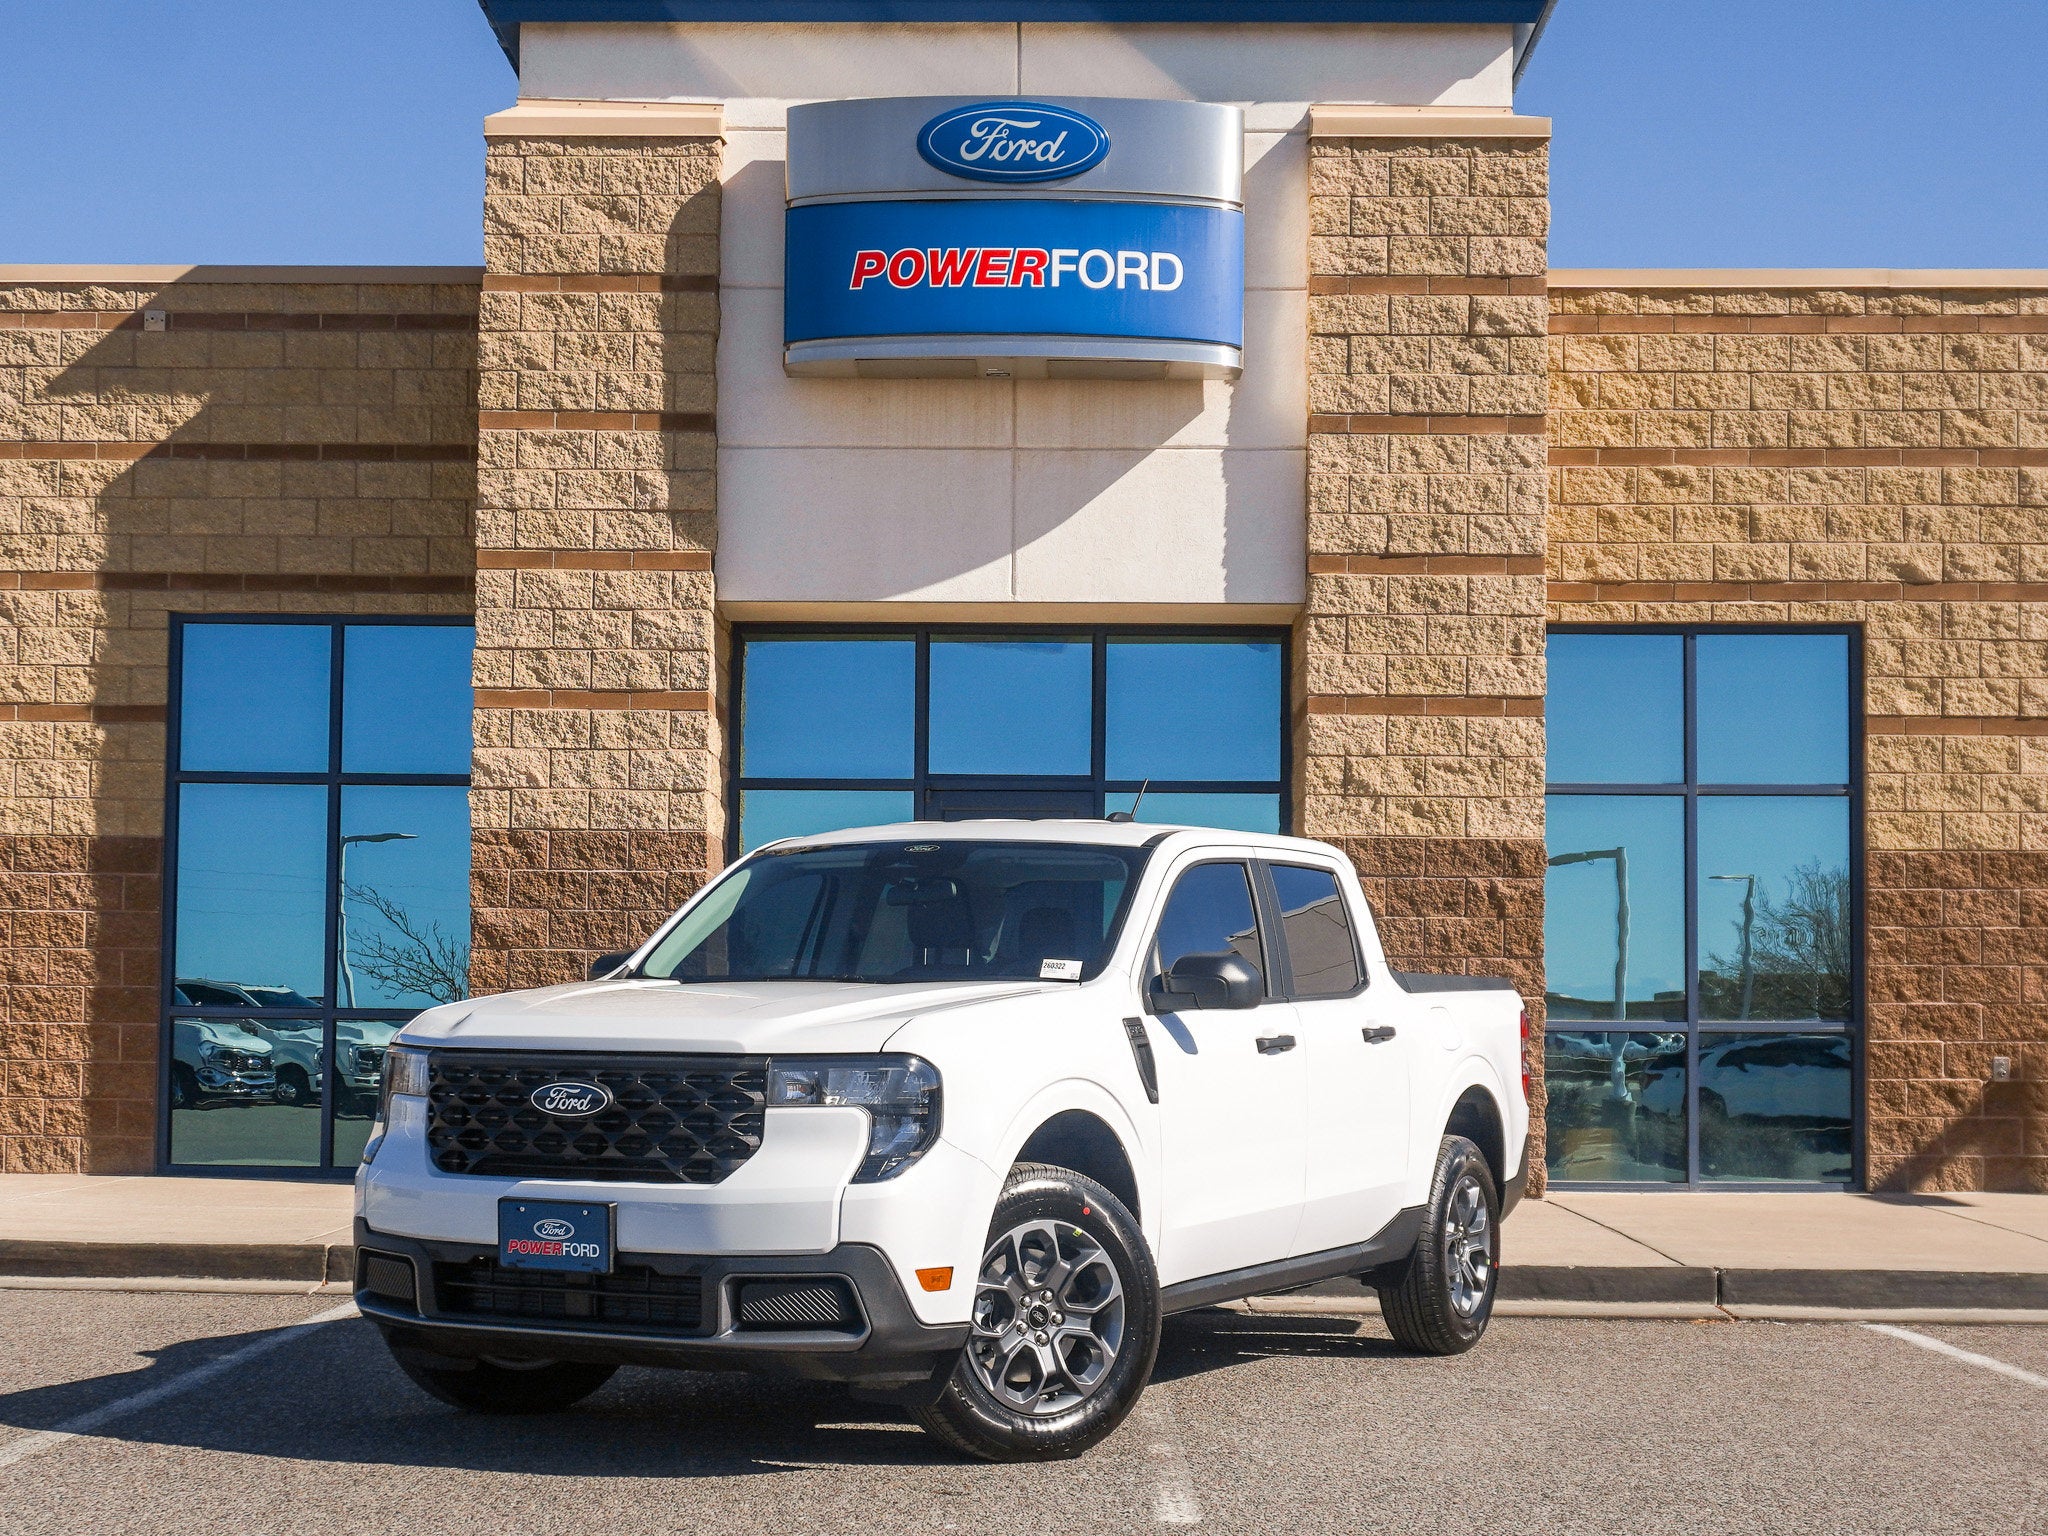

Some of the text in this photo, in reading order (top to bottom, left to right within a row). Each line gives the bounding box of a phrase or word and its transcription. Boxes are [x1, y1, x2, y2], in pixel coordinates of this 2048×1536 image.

[960, 117, 1068, 163] Ford
[1043, 962, 1066, 970] 260322
[545, 1087, 592, 1110] Ford
[541, 1222, 566, 1236] Ford
